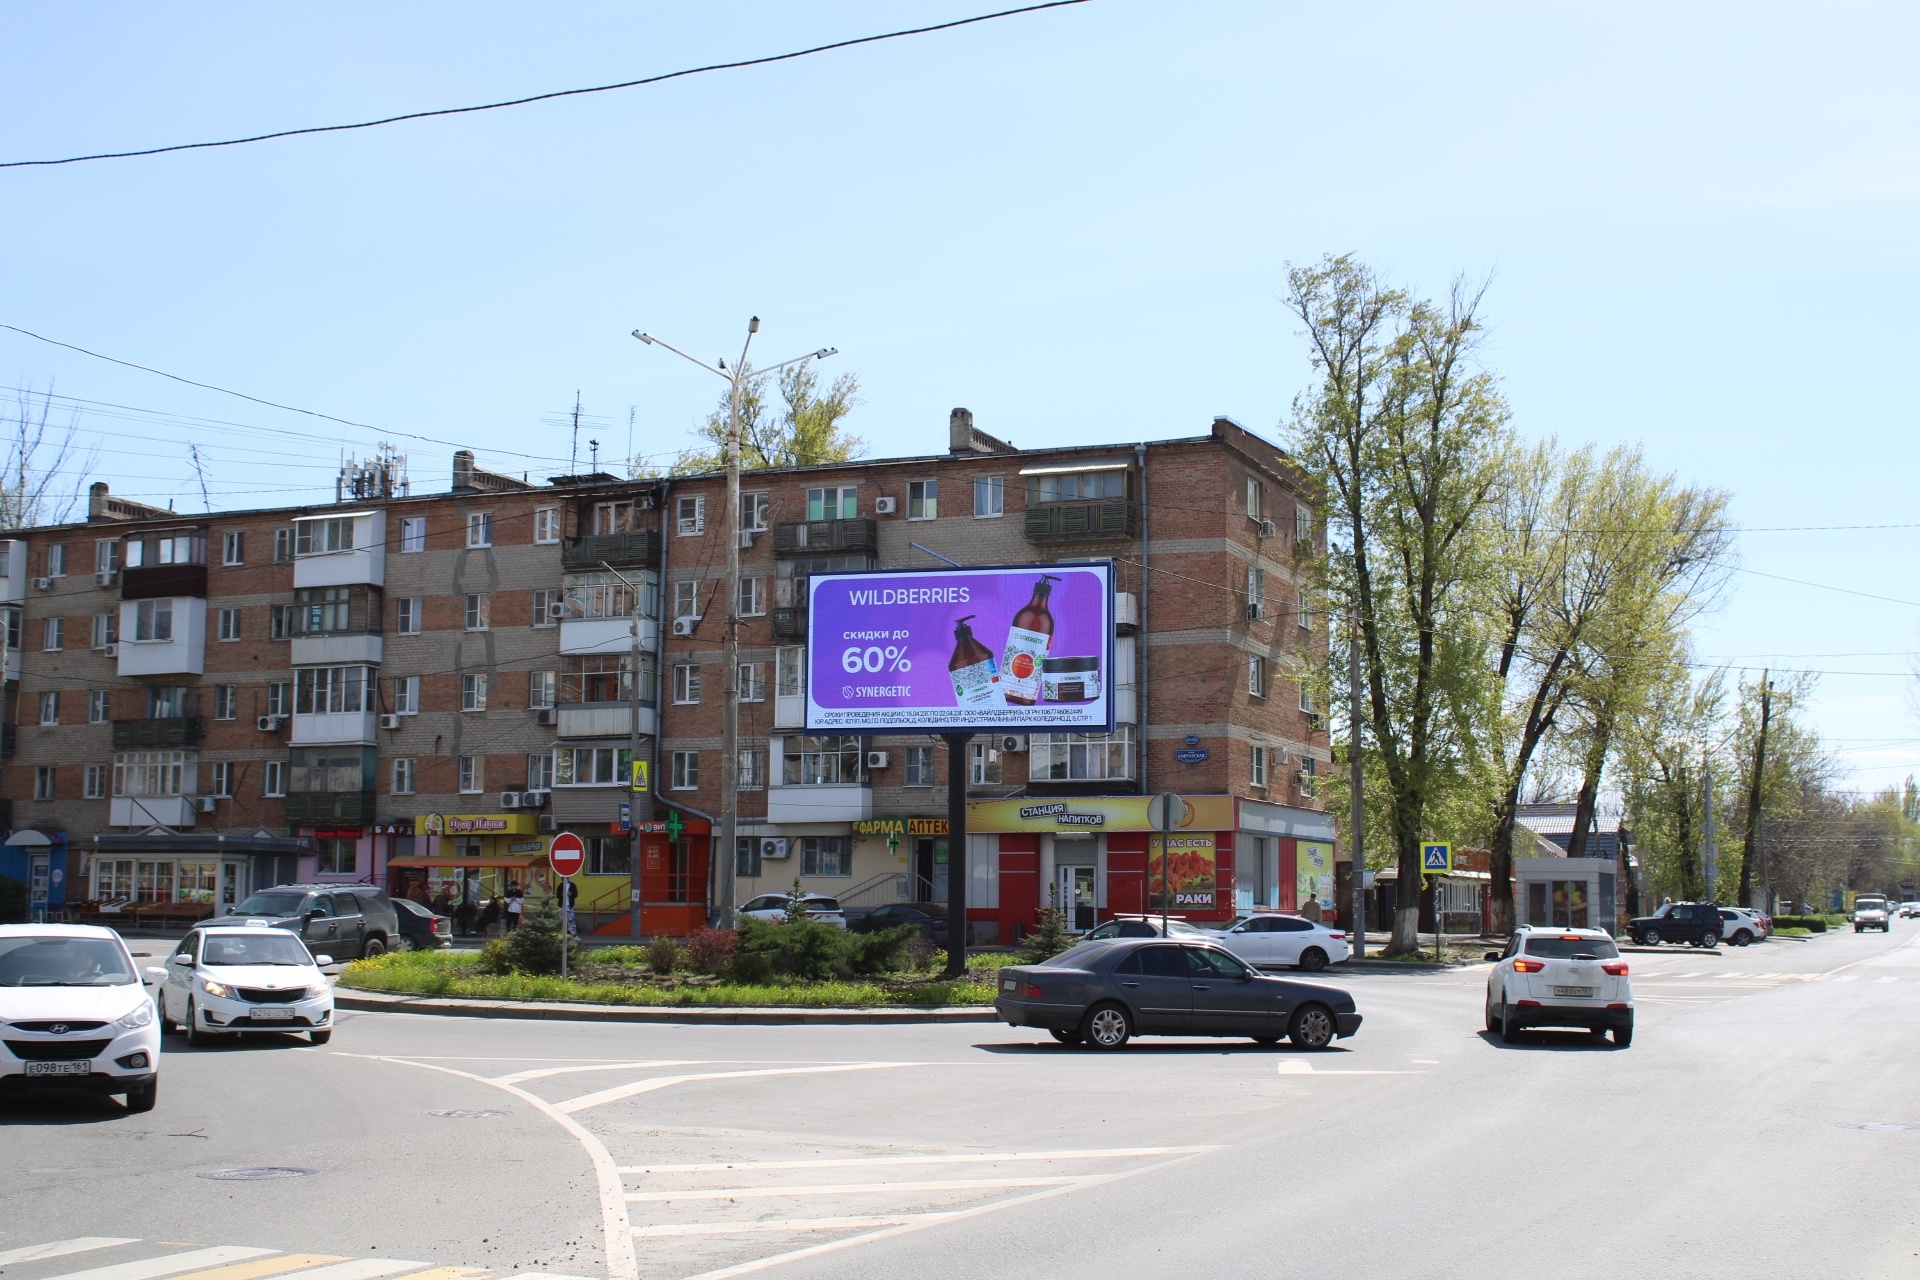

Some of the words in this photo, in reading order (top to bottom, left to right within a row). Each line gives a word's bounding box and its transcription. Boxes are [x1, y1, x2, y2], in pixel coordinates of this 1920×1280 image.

[849, 587, 970, 606] WILDBERRIES
[843, 631, 889, 640] скидки
[893, 630, 909, 640] до
[842, 646, 912, 674] 60%
[856, 686, 911, 698] SYNERGETIC
[1021, 804, 1064, 817] СТАНЦИЯ
[1058, 814, 1102, 825] НАПИТКОВ
[859, 820, 905, 834] ФАРМА
[909, 820, 948, 834] АПТЕК
[1153, 839, 1160, 848] У
[1186, 839, 1213, 847] ЕСТЬ
[1175, 893, 1212, 904] РАКИ
[29, 1062, 71, 1073] Е098ТЕ
[72, 1062, 88, 1071] 161
